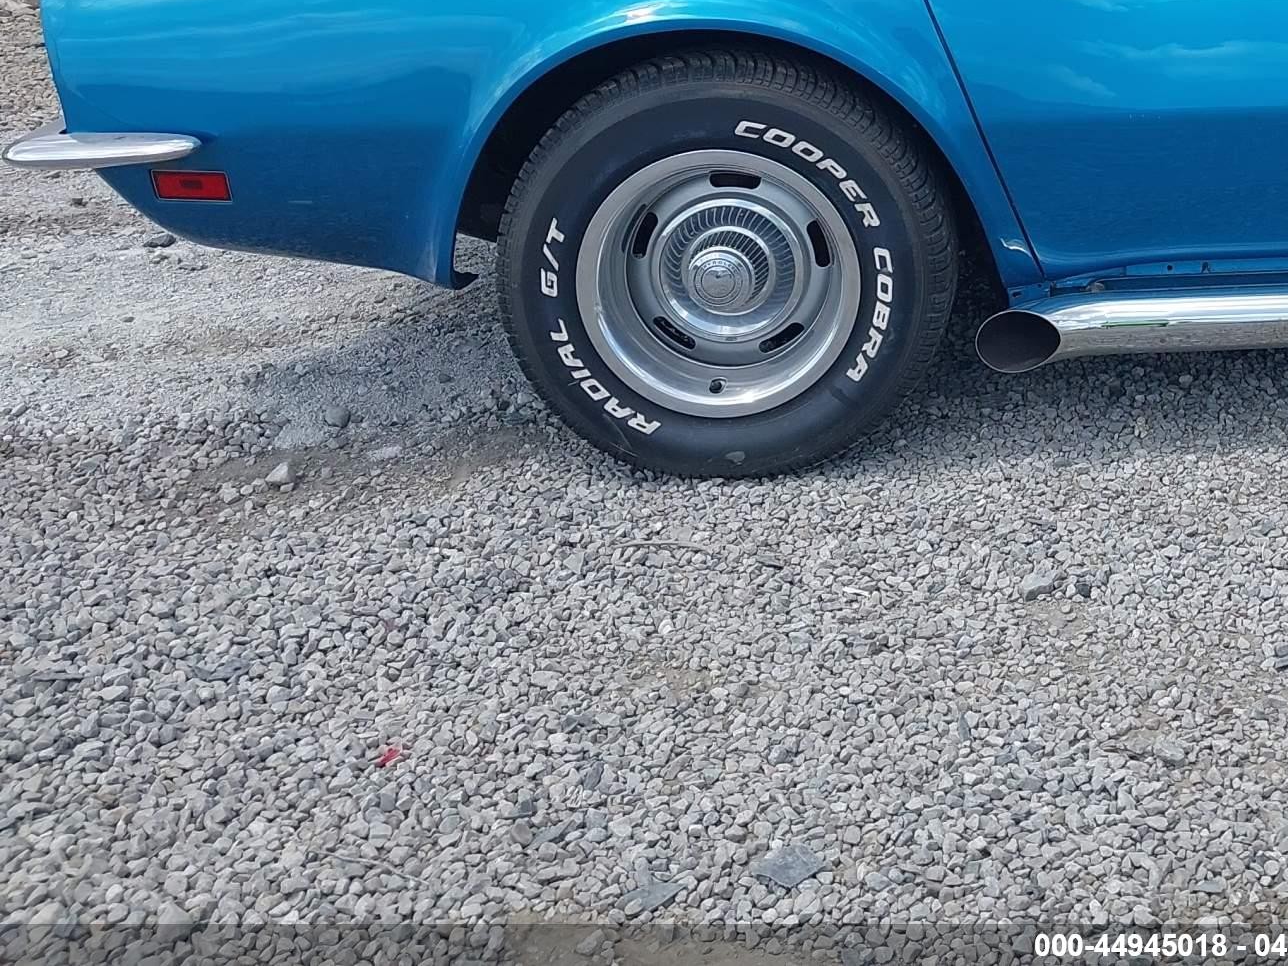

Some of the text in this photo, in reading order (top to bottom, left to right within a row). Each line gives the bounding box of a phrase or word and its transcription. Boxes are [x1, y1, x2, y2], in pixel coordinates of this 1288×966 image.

[540, 217, 662, 435] RADIAL G/T
[734, 120, 894, 383] COOPER COBRA
